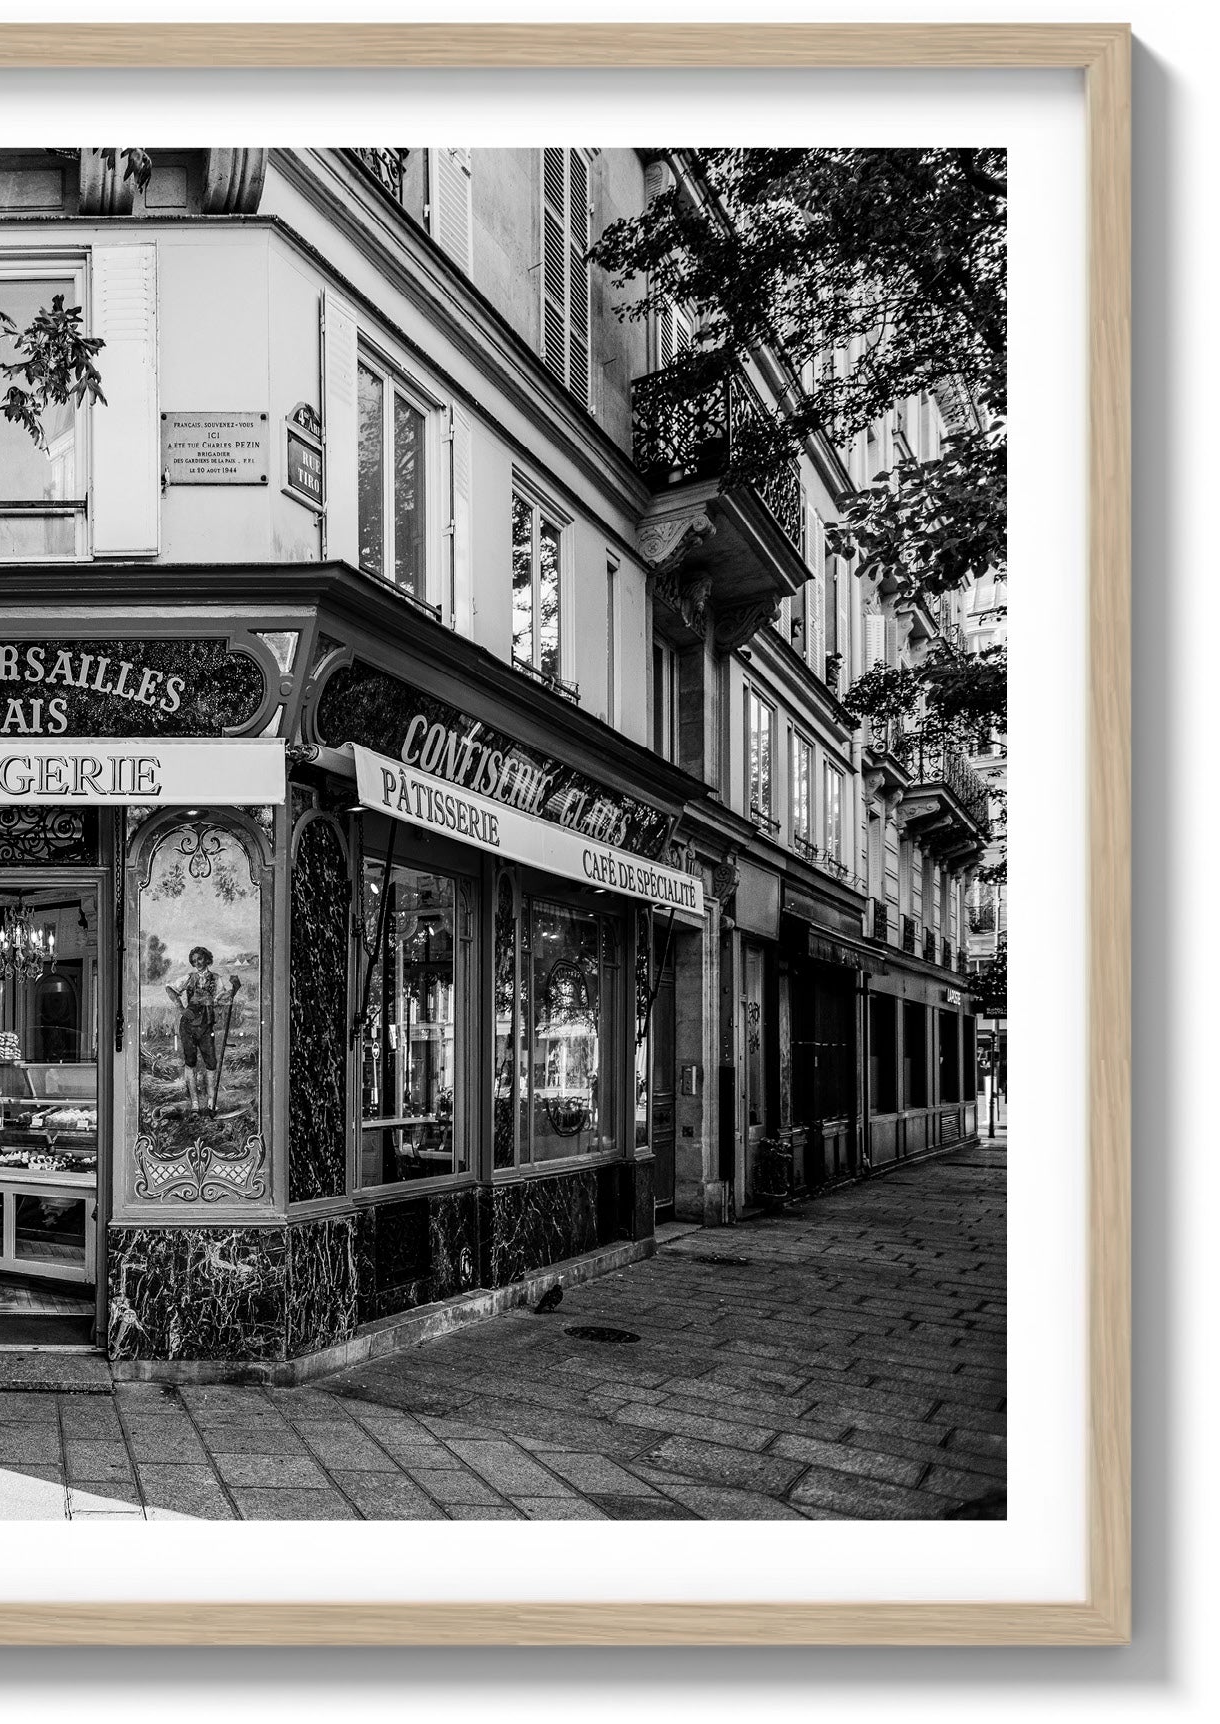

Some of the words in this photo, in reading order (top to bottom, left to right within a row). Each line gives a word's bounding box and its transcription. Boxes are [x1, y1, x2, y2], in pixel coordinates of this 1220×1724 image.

[298, 467, 320, 494] TIRO
[302, 450, 321, 475] RUE
[400, 714, 554, 817] CONFISERIE
[380, 767, 500, 847] PÂTISSERIE
[582, 848, 617, 886] CAFÉ
[617, 862, 636, 893] DE
[636, 866, 697, 909] SPÉCIALITÉ
